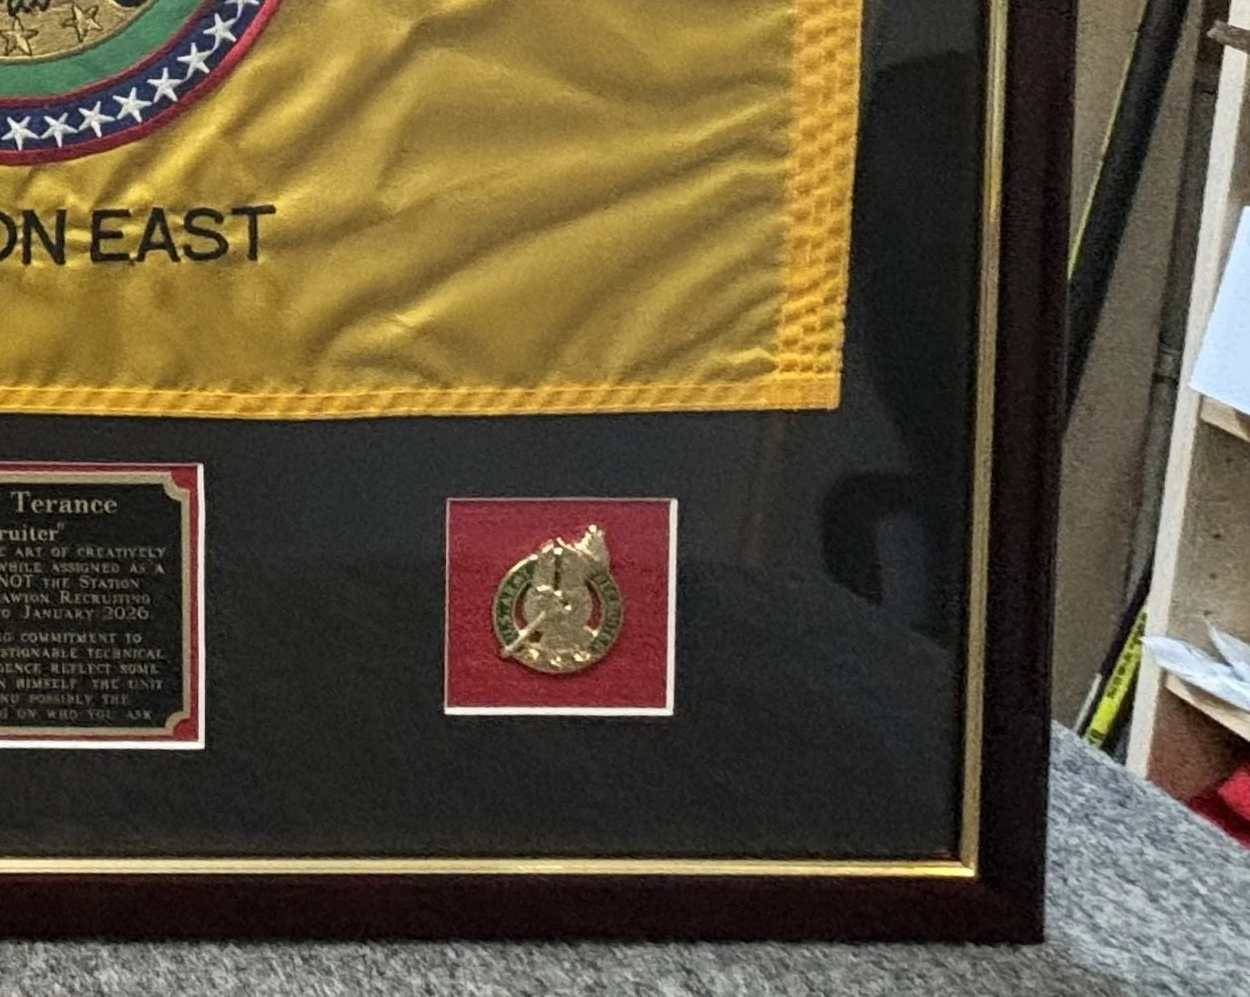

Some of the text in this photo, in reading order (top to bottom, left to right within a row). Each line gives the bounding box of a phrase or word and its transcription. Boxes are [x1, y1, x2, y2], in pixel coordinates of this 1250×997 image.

[90, 205, 276, 262] EAST
[10, 491, 118, 514] Terance
[15, 547, 42, 558] ART
[50, 547, 69, 558] OF
[77, 547, 166, 559] CREATIVELY
[52, 562, 120, 573] ASSIGNED
[155, 564, 165, 574] A
[42, 577, 70, 588] THE
[79, 575, 139, 589] STATION
[59, 590, 151, 605] RECRUITING
[23, 606, 94, 620] JANUARY
[20, 632, 117, 643] COMMITMENT
[125, 633, 142, 643] TO
[87, 648, 164, 660] TECHNICAL
[92, 679, 120, 690] THE
